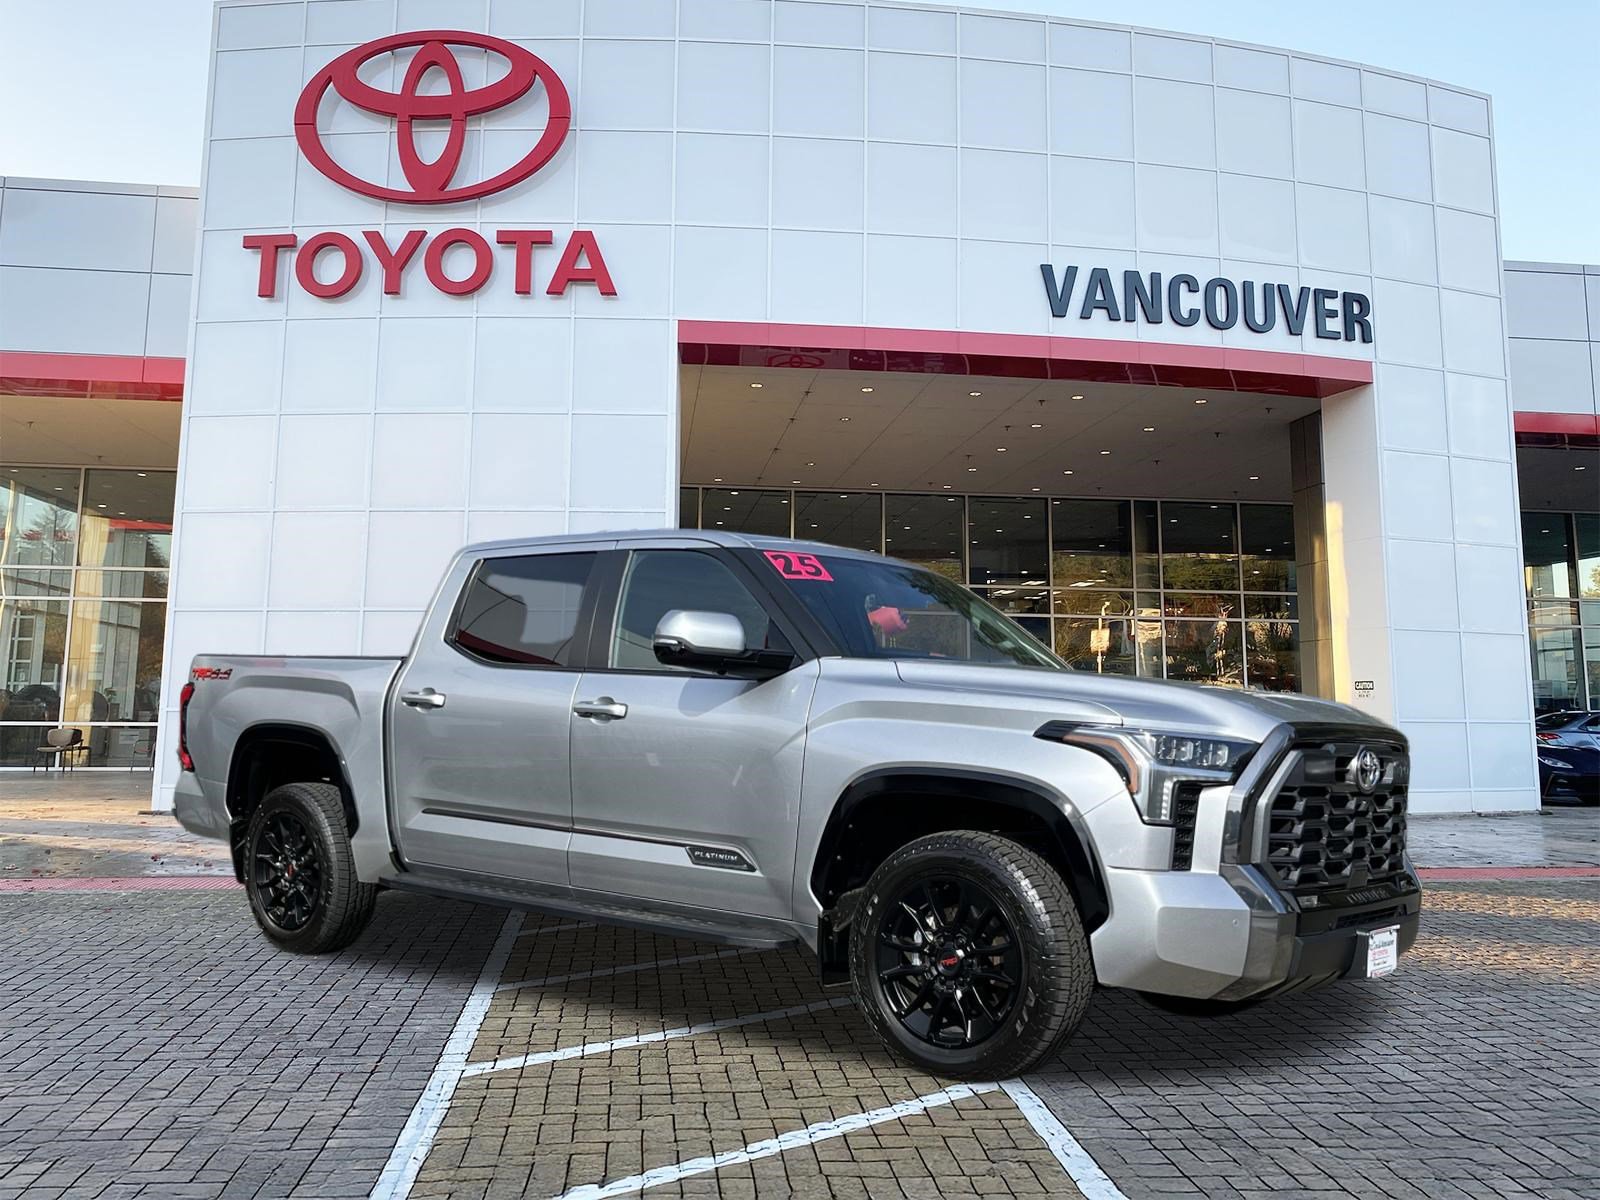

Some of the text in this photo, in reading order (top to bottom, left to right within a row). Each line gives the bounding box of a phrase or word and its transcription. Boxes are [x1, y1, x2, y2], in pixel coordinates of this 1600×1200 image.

[243, 228, 618, 298] TOYOTA
[1040, 264, 1373, 343] VANCOUVER
[771, 553, 823, 578] 25
[694, 850, 738, 861] PLATINUM
